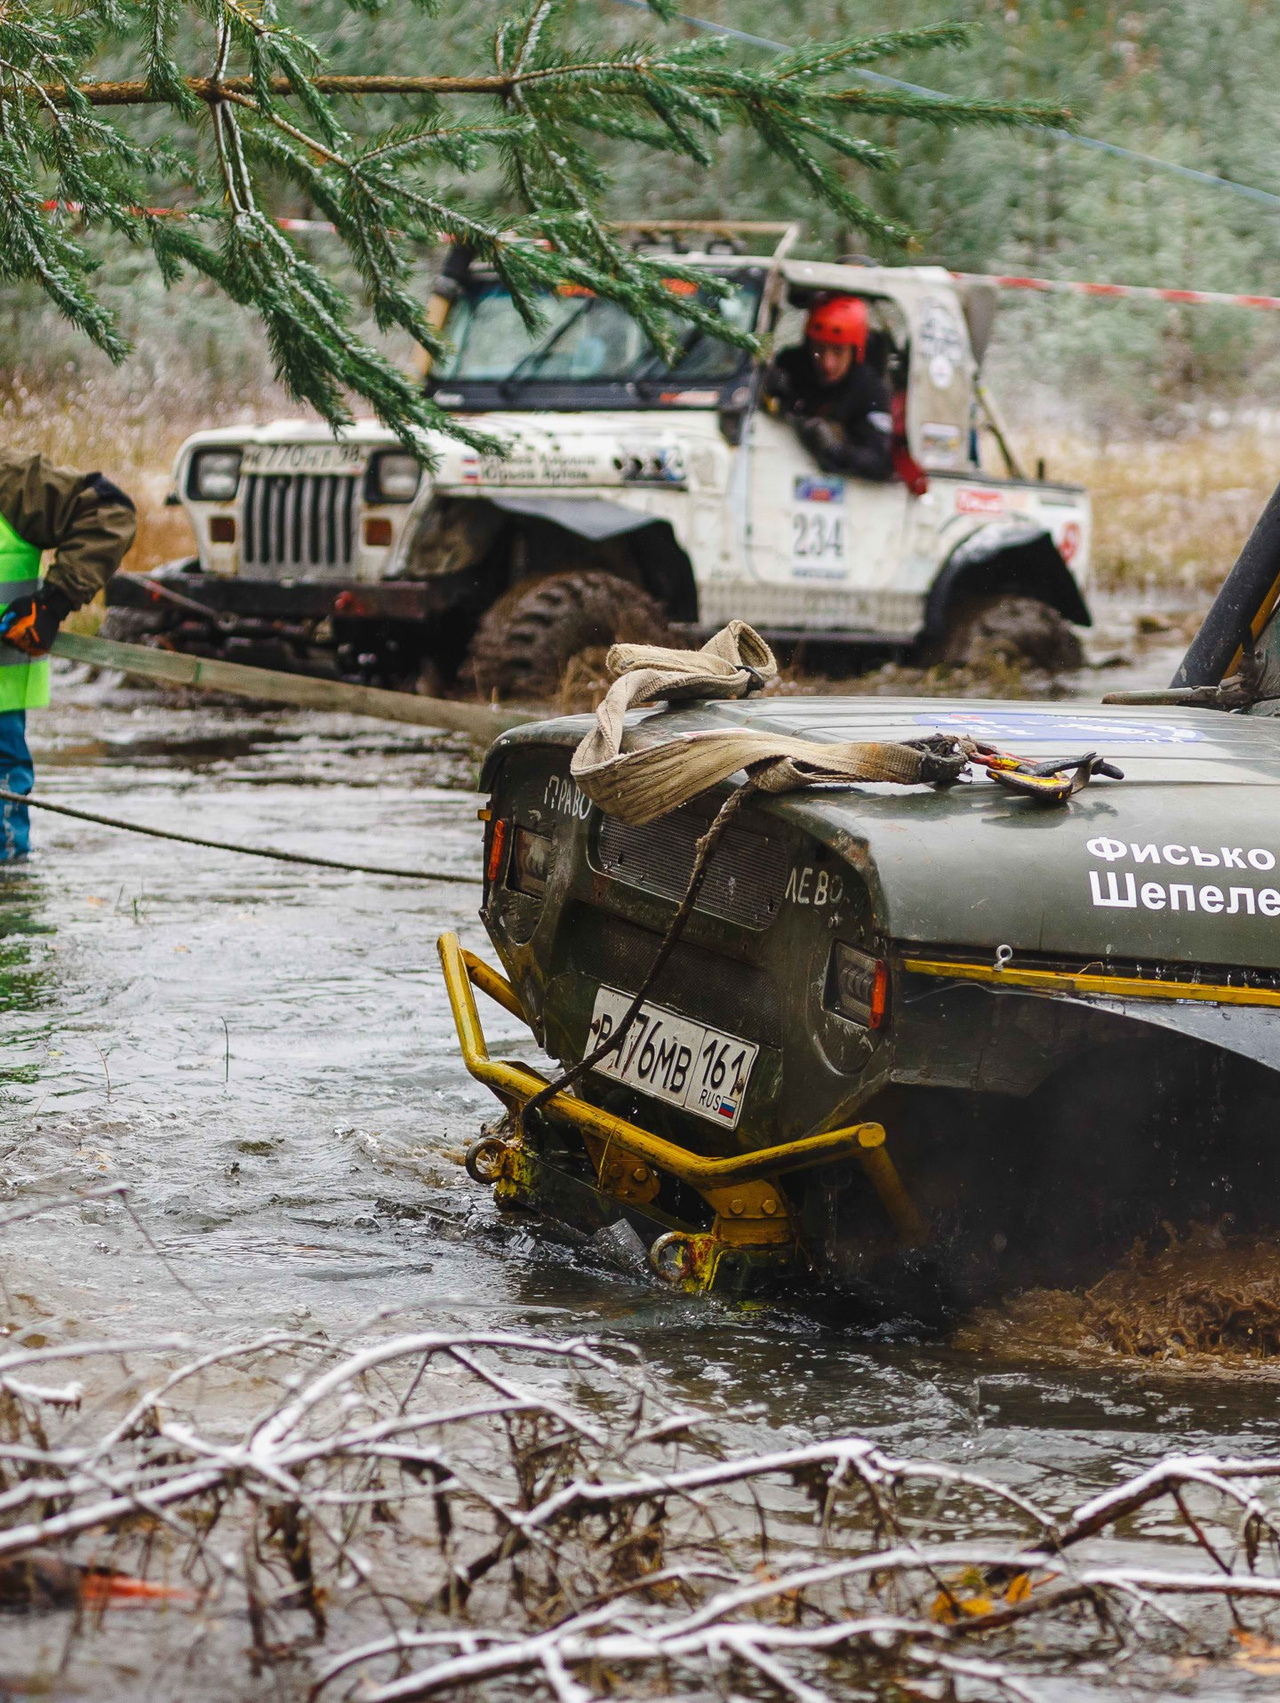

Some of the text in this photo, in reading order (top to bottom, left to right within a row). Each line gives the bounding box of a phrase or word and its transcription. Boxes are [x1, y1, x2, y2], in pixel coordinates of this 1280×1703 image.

[793, 512, 844, 557] 234
[544, 774, 593, 820] ПРАВО
[1086, 836, 1276, 871] Фисько
[702, 1037, 747, 1097] 161
[698, 1089, 721, 1112] RUS
